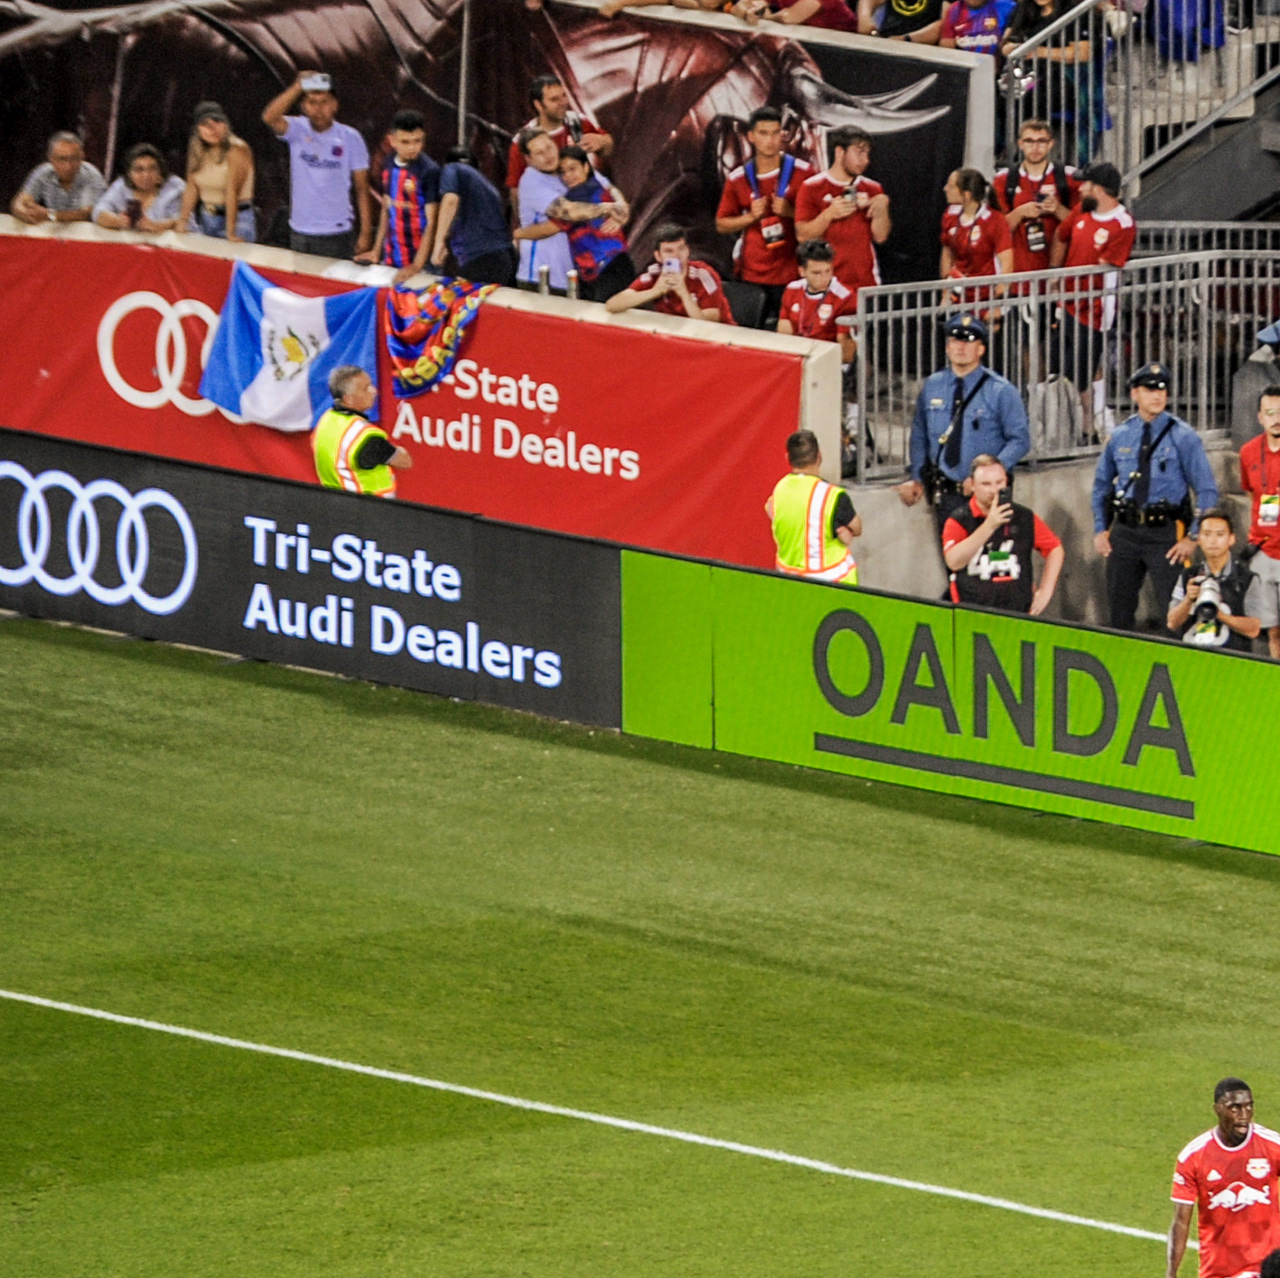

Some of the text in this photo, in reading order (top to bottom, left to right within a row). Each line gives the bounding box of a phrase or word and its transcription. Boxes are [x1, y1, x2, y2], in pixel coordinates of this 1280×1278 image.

[392, 402, 640, 481] Audi Dealers
[244, 516, 462, 602] Tri-State
[243, 583, 562, 688] Audi Dealers
[812, 608, 1196, 777] OANDA
